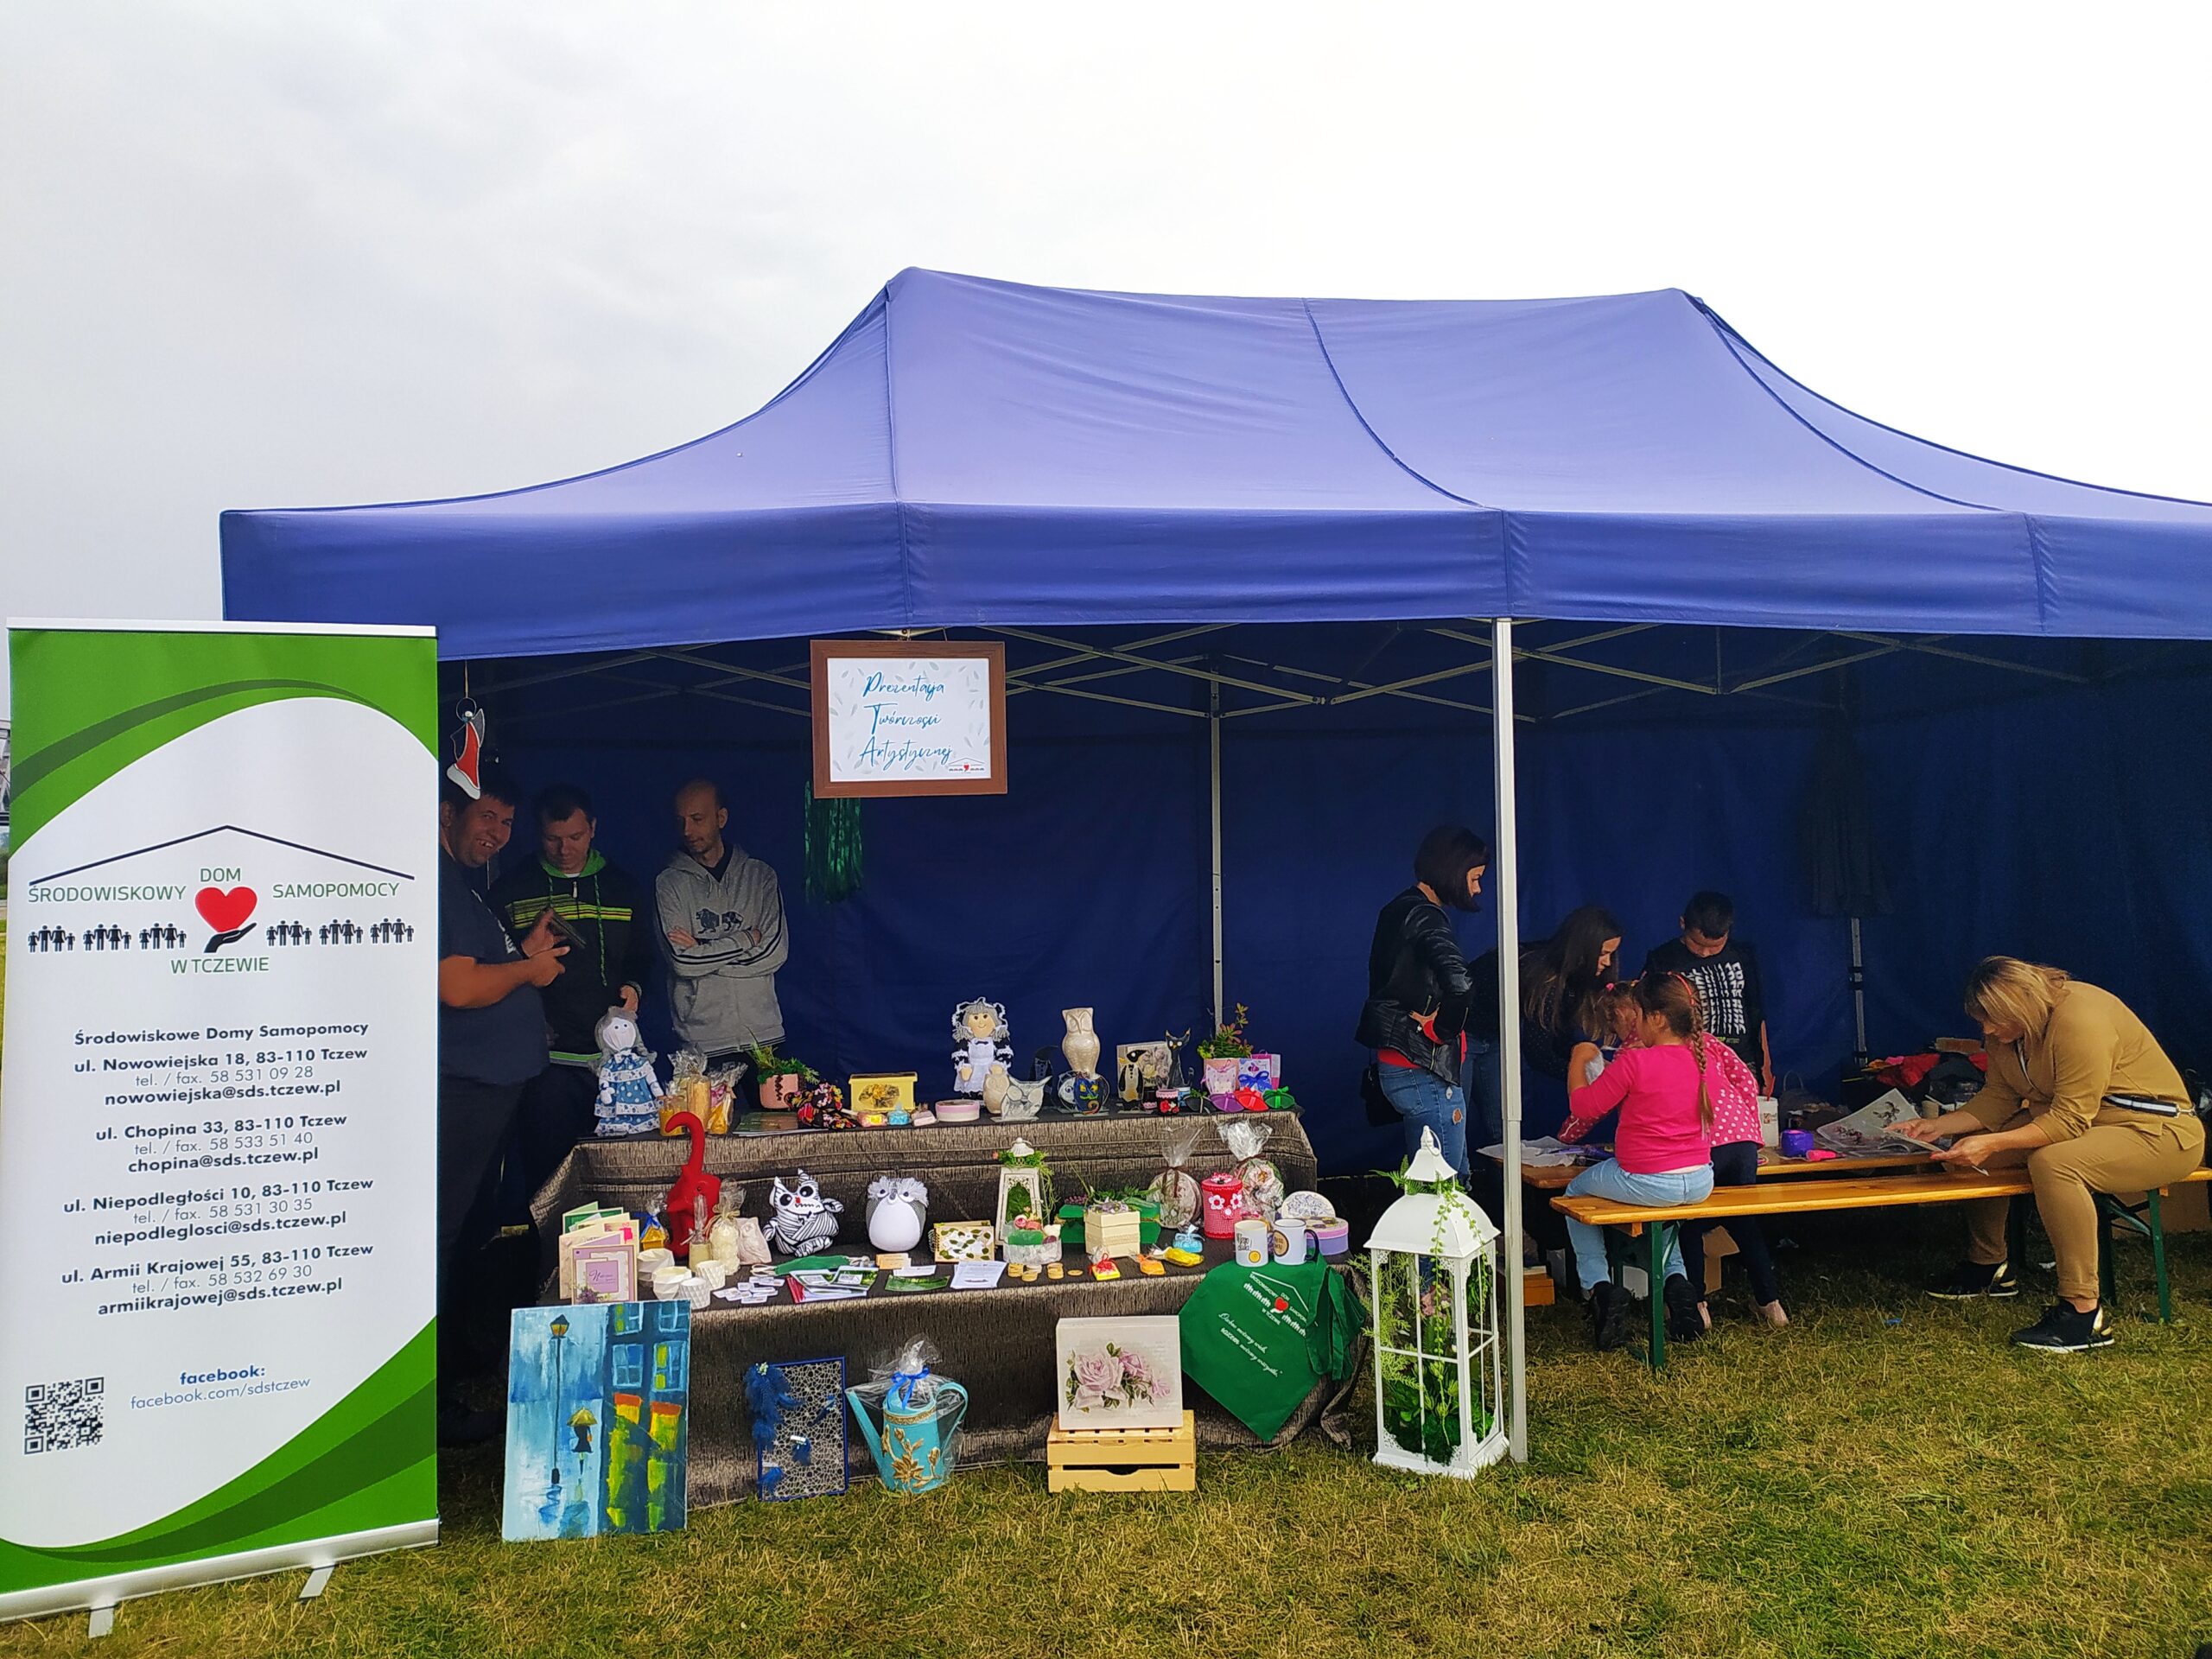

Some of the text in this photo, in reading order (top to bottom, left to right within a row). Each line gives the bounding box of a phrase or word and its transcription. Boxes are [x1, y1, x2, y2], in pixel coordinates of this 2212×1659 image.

[859, 735, 953, 771] Artystycznej
[200, 868, 242, 883] DOM
[28, 884, 187, 903] ŚRODOWISKOWY
[272, 881, 400, 899] SAMOPOMOCY
[170, 957, 270, 976] W TCZEWIE
[73, 1024, 370, 1046] Środowiskowe Domy Samopomocy
[73, 1048, 368, 1073] ul. Nowowiejska 18, 83-110 Tczew
[135, 1065, 314, 1087] tel. / fax. 58 531 09 28
[105, 1079, 341, 1106] nowowiejska@sds.tczew.pl
[95, 1115, 348, 1141] ul. Chopina 33, 83-110 Tczew
[134, 1131, 314, 1155] tel. / fax. 58 533 51 40
[127, 1146, 319, 1174] chopina@sds.tczew.pl
[63, 1179, 374, 1213] ul. Niepodległości 10, 83-110 Tczew
[132, 1197, 313, 1224] tel. / fax. 58 531 30 35
[94, 1210, 346, 1247] niepodleglosci@sds.tczew.pl
[61, 1245, 374, 1284] ul. Armii Krajowej 55, 83-110 Tczew
[132, 1264, 313, 1294] tel. / fax. 58 532 69 30
[98, 1276, 342, 1316] armiikrajowej@sds.tczew.pl
[179, 1364, 265, 1386] facebook:
[130, 1378, 311, 1409] facebook.com/sdstczew
